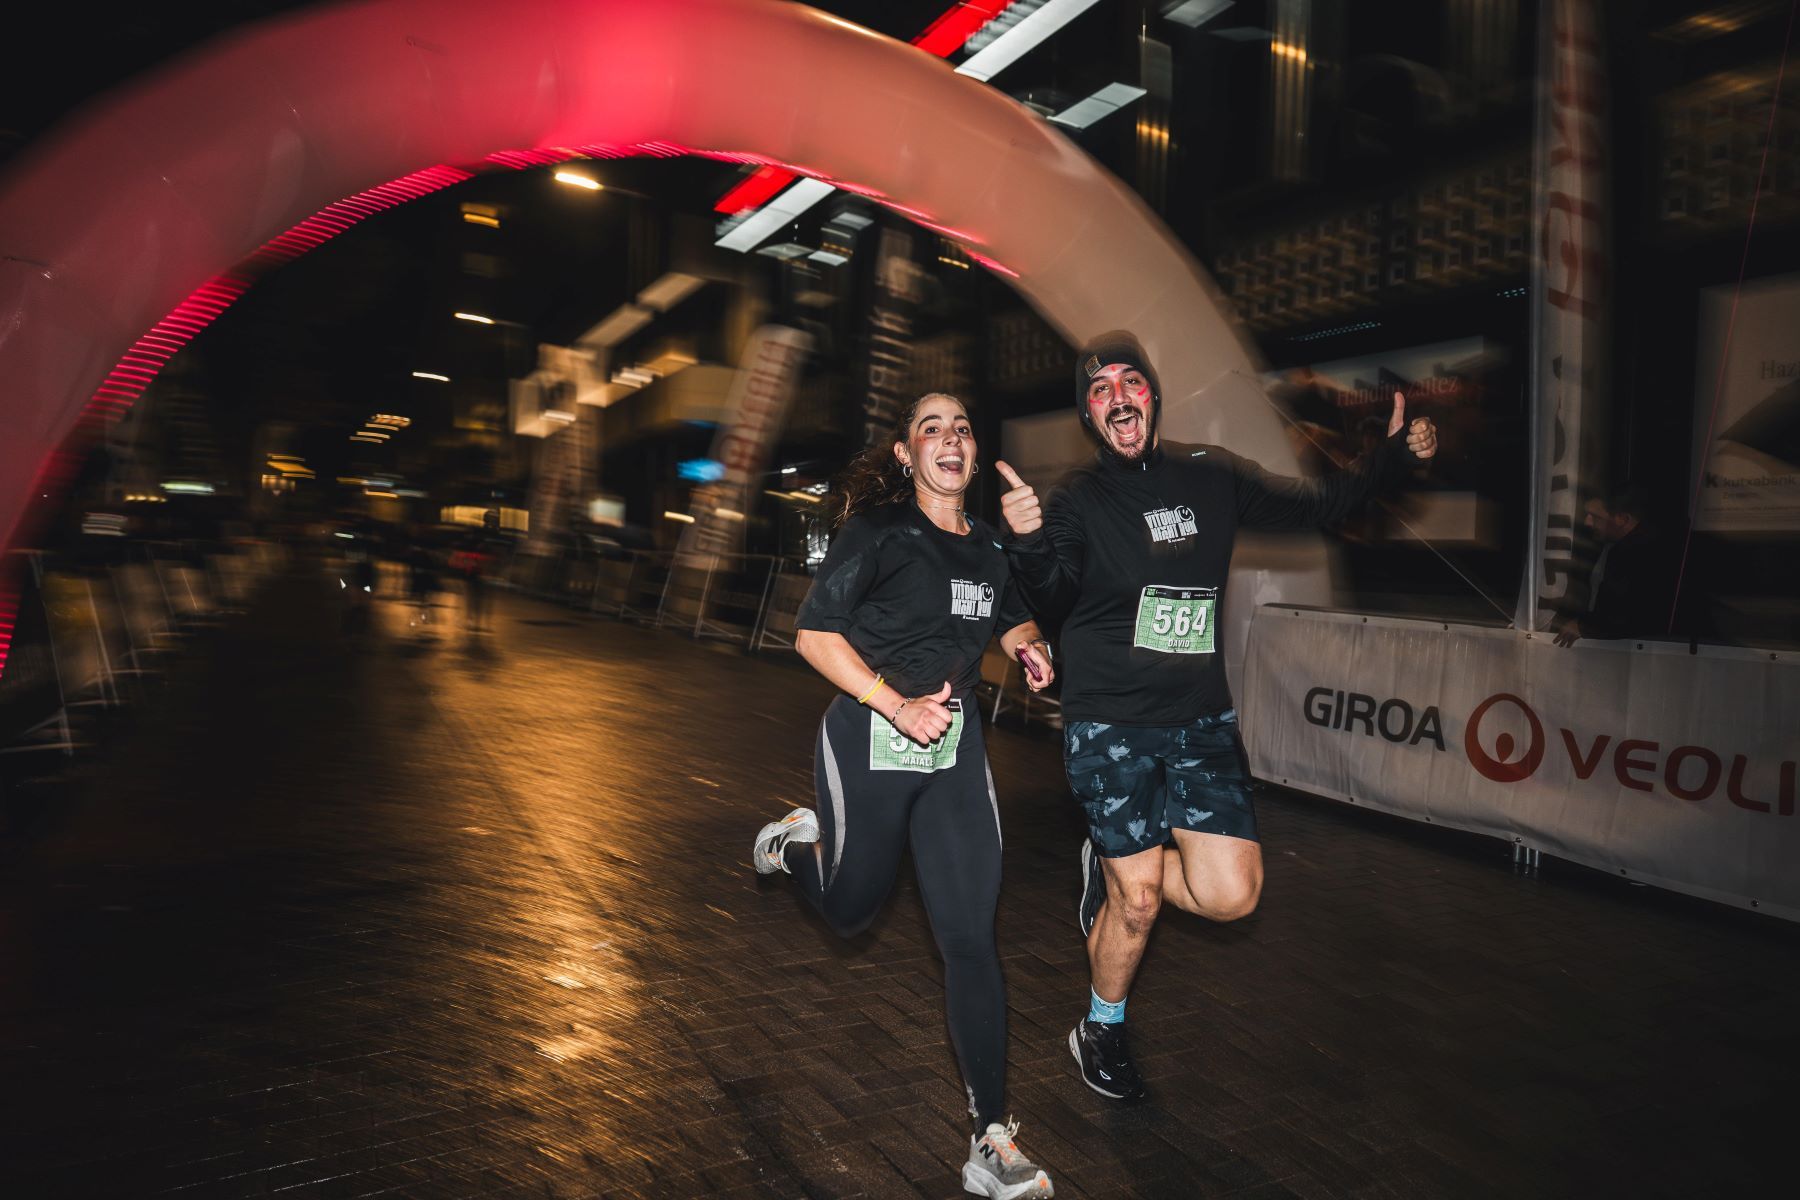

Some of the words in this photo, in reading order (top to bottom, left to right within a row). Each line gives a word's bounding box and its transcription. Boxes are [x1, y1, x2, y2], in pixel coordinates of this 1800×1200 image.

[1152, 604, 1207, 637] 564
[1168, 639, 1191, 648] DAVID
[1303, 687, 1446, 752] GIROA
[979, 1143, 995, 1160] N
